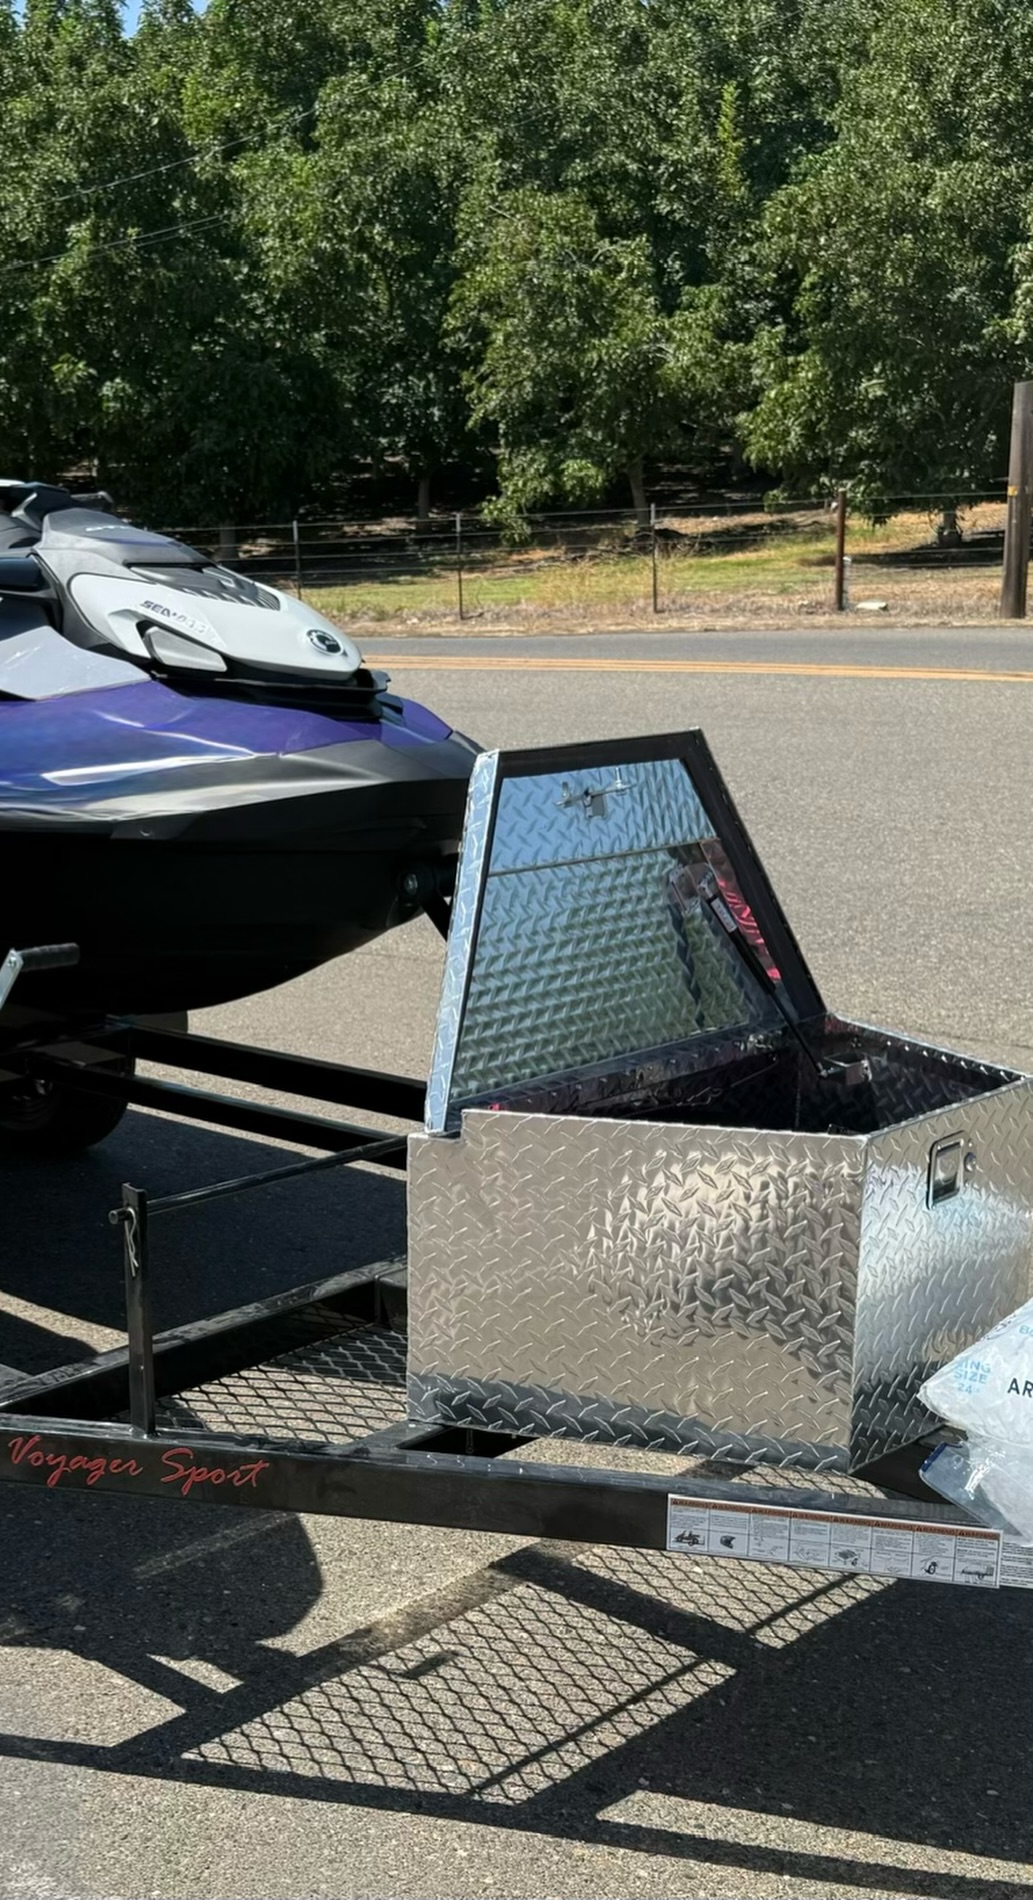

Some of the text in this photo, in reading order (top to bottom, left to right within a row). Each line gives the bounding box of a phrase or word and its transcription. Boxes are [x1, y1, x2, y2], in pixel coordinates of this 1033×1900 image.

[953, 1370, 988, 1384] SIZE
[8, 1434, 270, 1496] Voyager Sport
